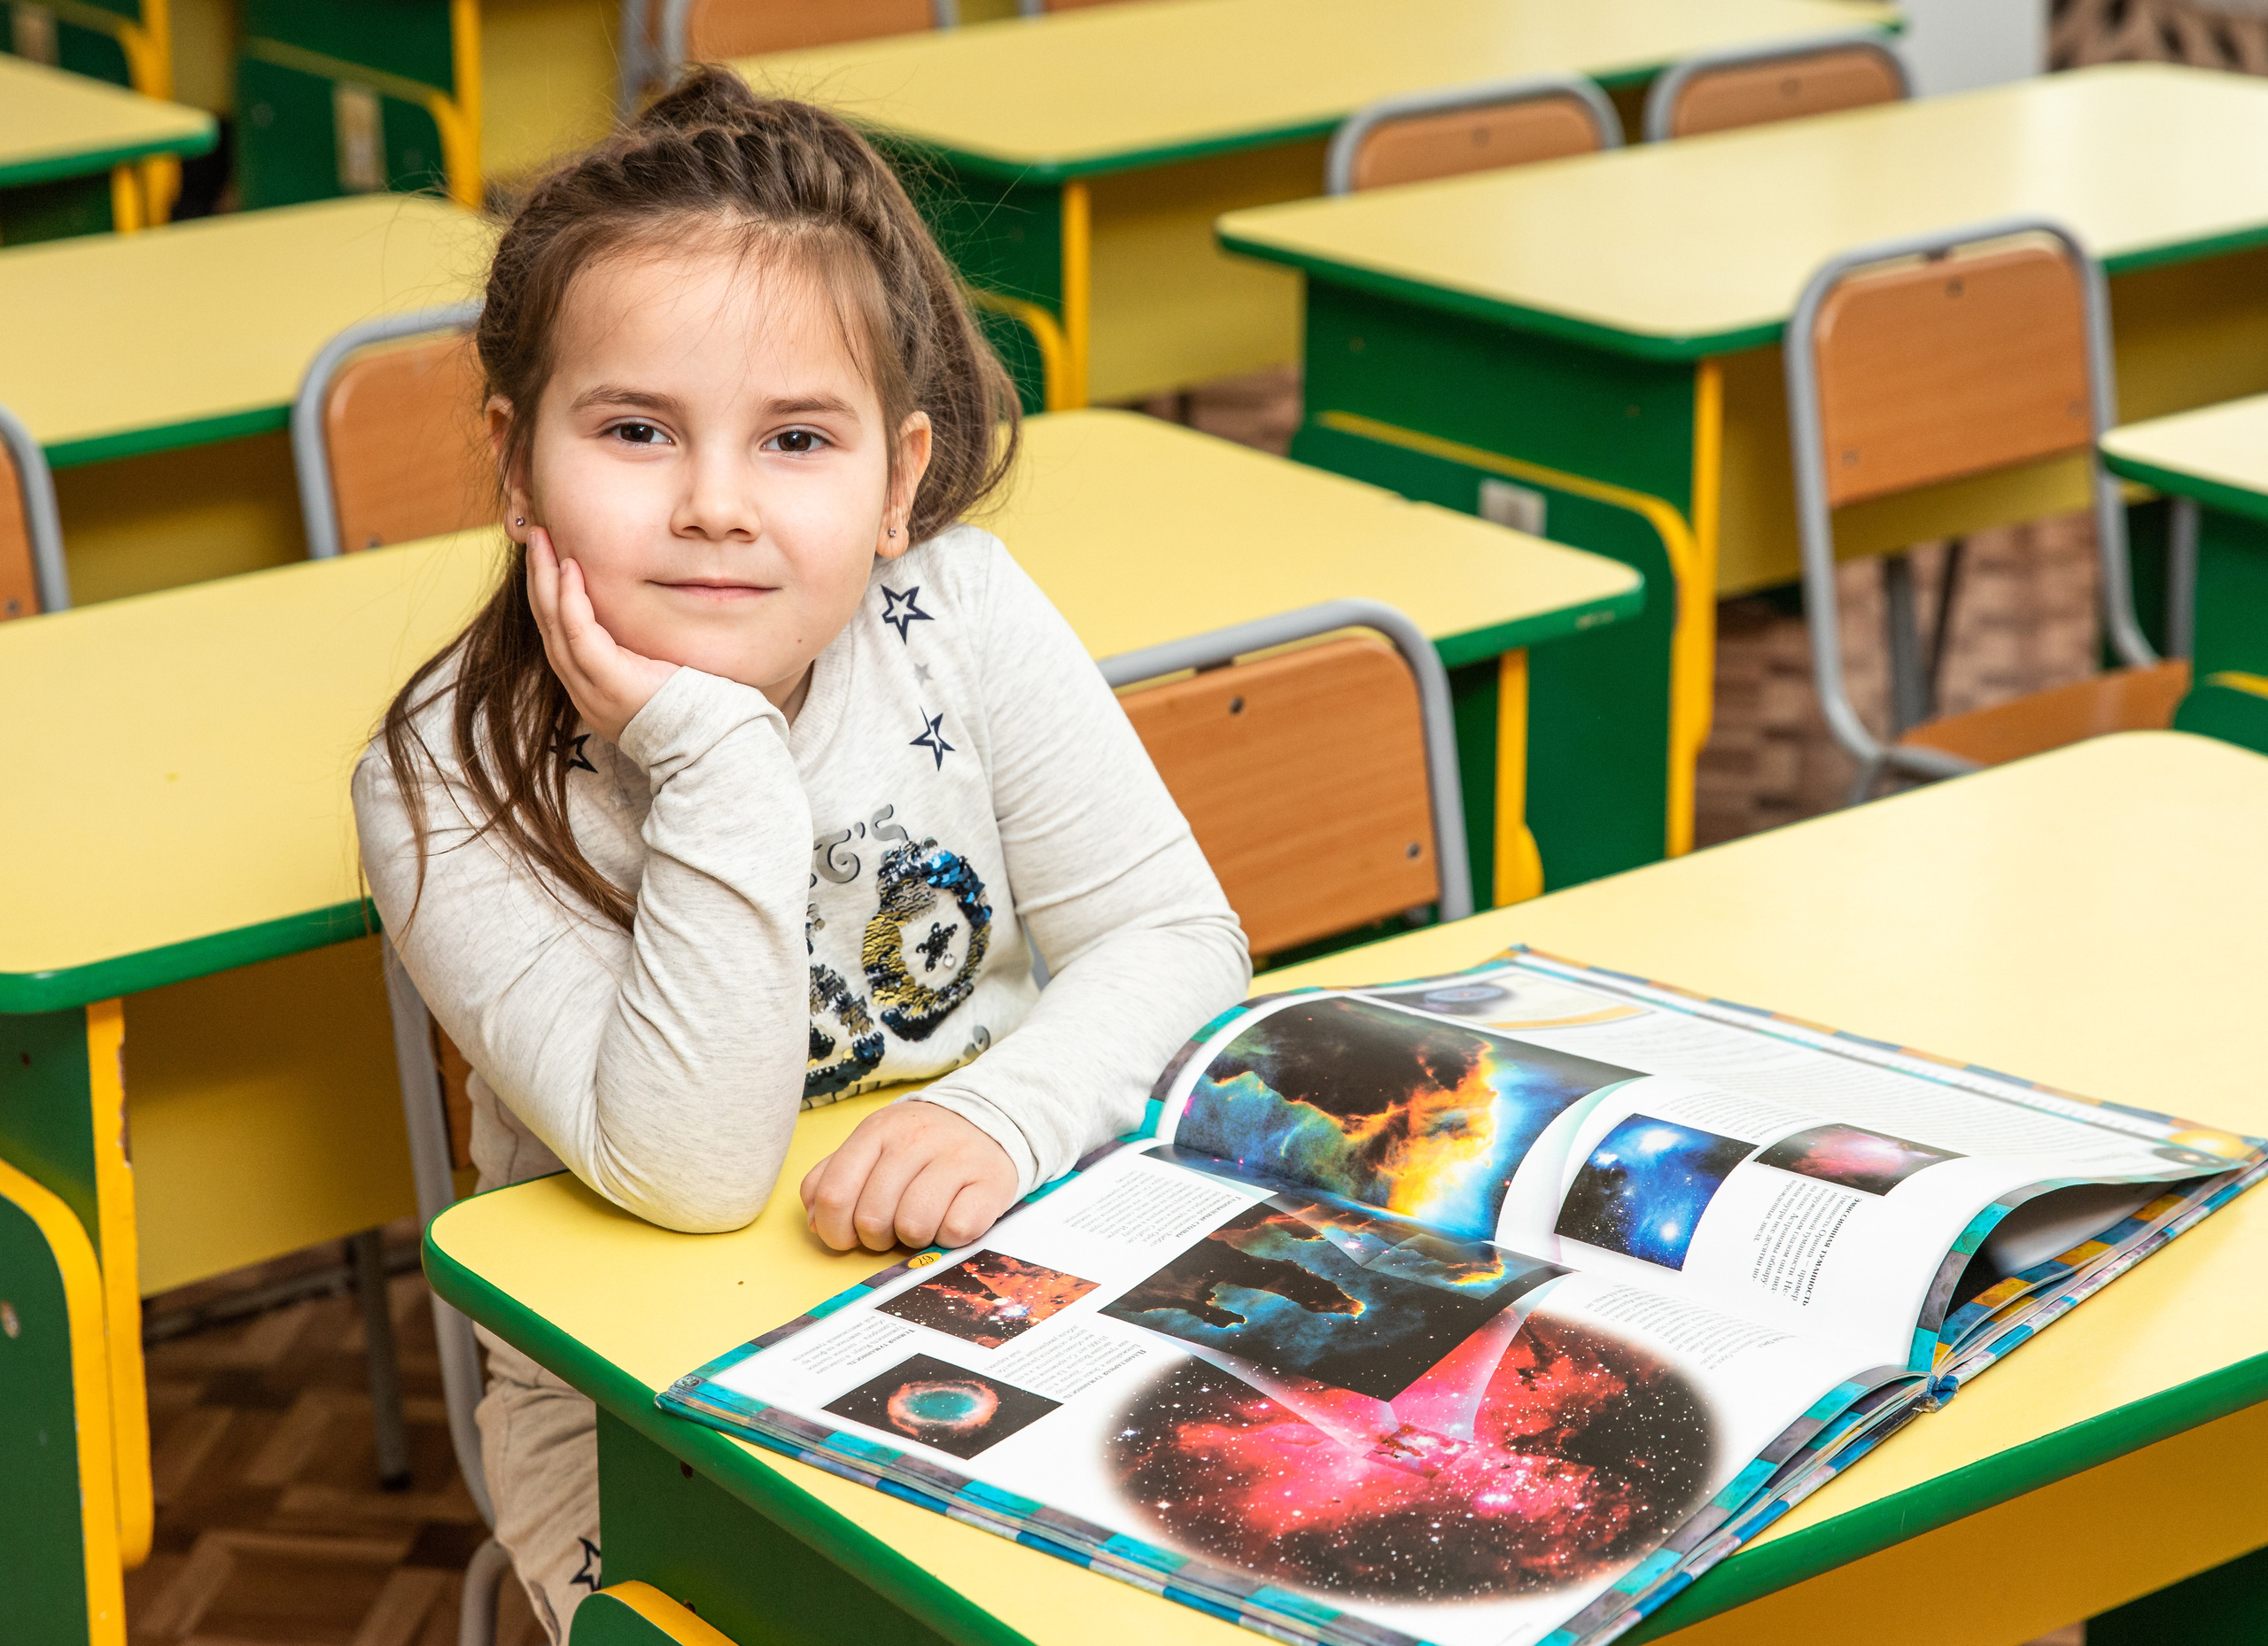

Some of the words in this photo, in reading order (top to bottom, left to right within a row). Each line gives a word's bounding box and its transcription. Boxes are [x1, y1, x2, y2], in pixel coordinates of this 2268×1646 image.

[1776, 1197, 1797, 1220] внутри
[1771, 1212, 1798, 1254] Астрономы
[1782, 1231, 1800, 1257] глазом
[1806, 1228, 1826, 1258] Ориона
[917, 1254, 934, 1267] 67
[1755, 1234, 1774, 1266] десятки
[1749, 1267, 1759, 1282] но-
[1759, 1254, 1776, 1288] обнару-
[1775, 1258, 1787, 1274] она
[1780, 1279, 1791, 1297] Не-
[1790, 1269, 1807, 1301] пример
